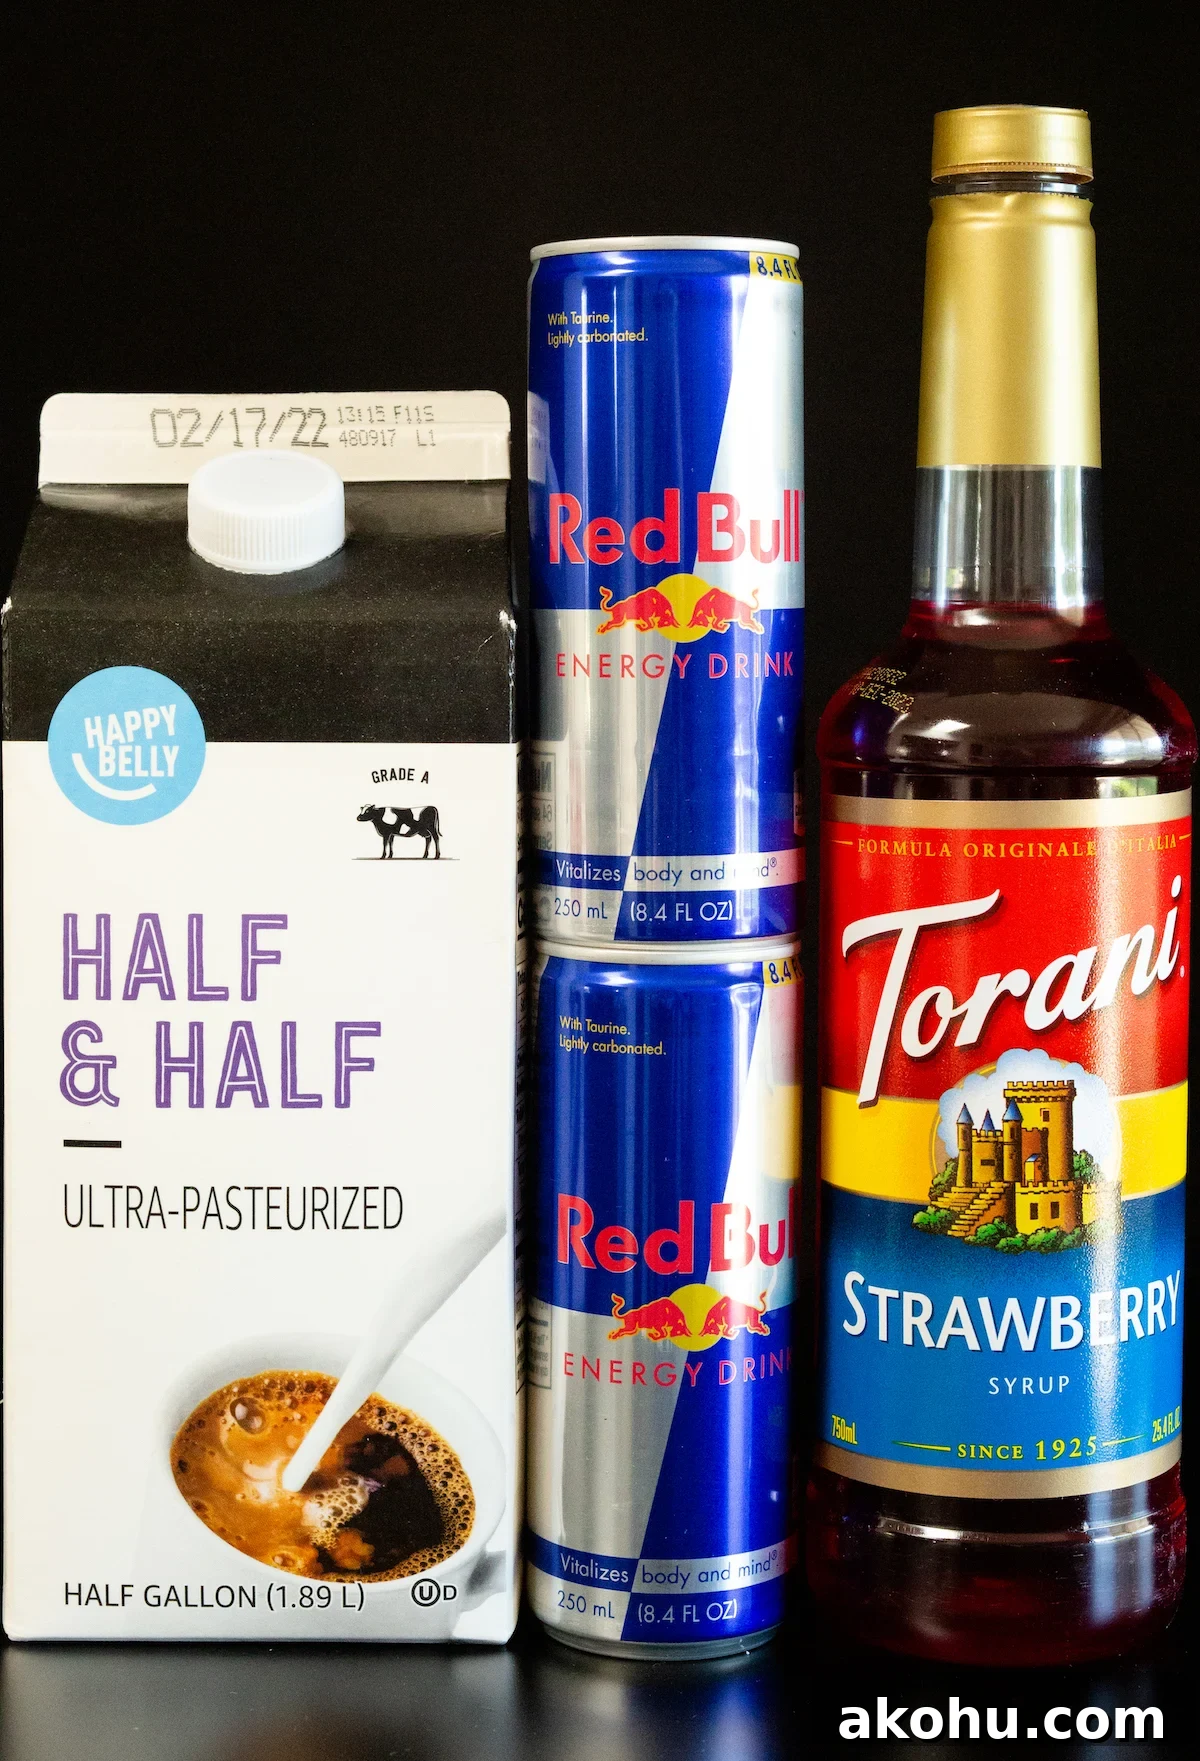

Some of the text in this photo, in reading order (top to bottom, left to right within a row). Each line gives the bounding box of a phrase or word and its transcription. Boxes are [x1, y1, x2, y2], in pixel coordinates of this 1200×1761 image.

[756, 256, 783, 277] 8.4
[547, 311, 614, 326] With Taurine.
[547, 328, 649, 348] Lightly carbonated.
[150, 407, 329, 448] 02/17/22
[339, 428, 396, 448] 480917
[549, 488, 801, 566] Red Bull
[556, 651, 794, 679] ENERGY DRINK
[84, 704, 178, 749] HAPPY
[98, 744, 180, 779] BELLY
[371, 767, 429, 784] GRADE A
[857, 838, 952, 858] FORMULA
[963, 840, 1096, 859] ORIGINALE
[556, 859, 621, 882] Vitalizes
[634, 862, 684, 887] body
[689, 862, 725, 881] and
[554, 897, 581, 918] 250
[587, 900, 608, 919] mL
[629, 903, 668, 923] (8.4
[675, 903, 693, 922] FL
[699, 900, 734, 922] OZ)
[62, 912, 288, 1001] HALF
[768, 961, 792, 984] 8.4
[841, 874, 1182, 1109] Torani
[559, 1015, 631, 1035] With Taurine.
[559, 1034, 667, 1056] Lightly carbonated.
[59, 1019, 382, 1109] & HALF
[63, 1184, 404, 1230] ULTRA-PASTEURIZED
[557, 1192, 695, 1275] Red
[842, 1268, 1181, 1352] STRAWBERRY
[563, 1351, 704, 1387] ENERGY
[988, 1375, 1070, 1395] SYRUP
[831, 1414, 858, 1446] 750mL
[956, 1435, 1098, 1462] SINCE 1925
[560, 1552, 629, 1583] Vitalizes
[641, 1564, 691, 1589] body
[697, 1562, 731, 1583] and
[64, 1581, 366, 1612] HALF GALLON (1.89 L)
[557, 1590, 738, 1624] 250 mL (8.4 FL OZ)
